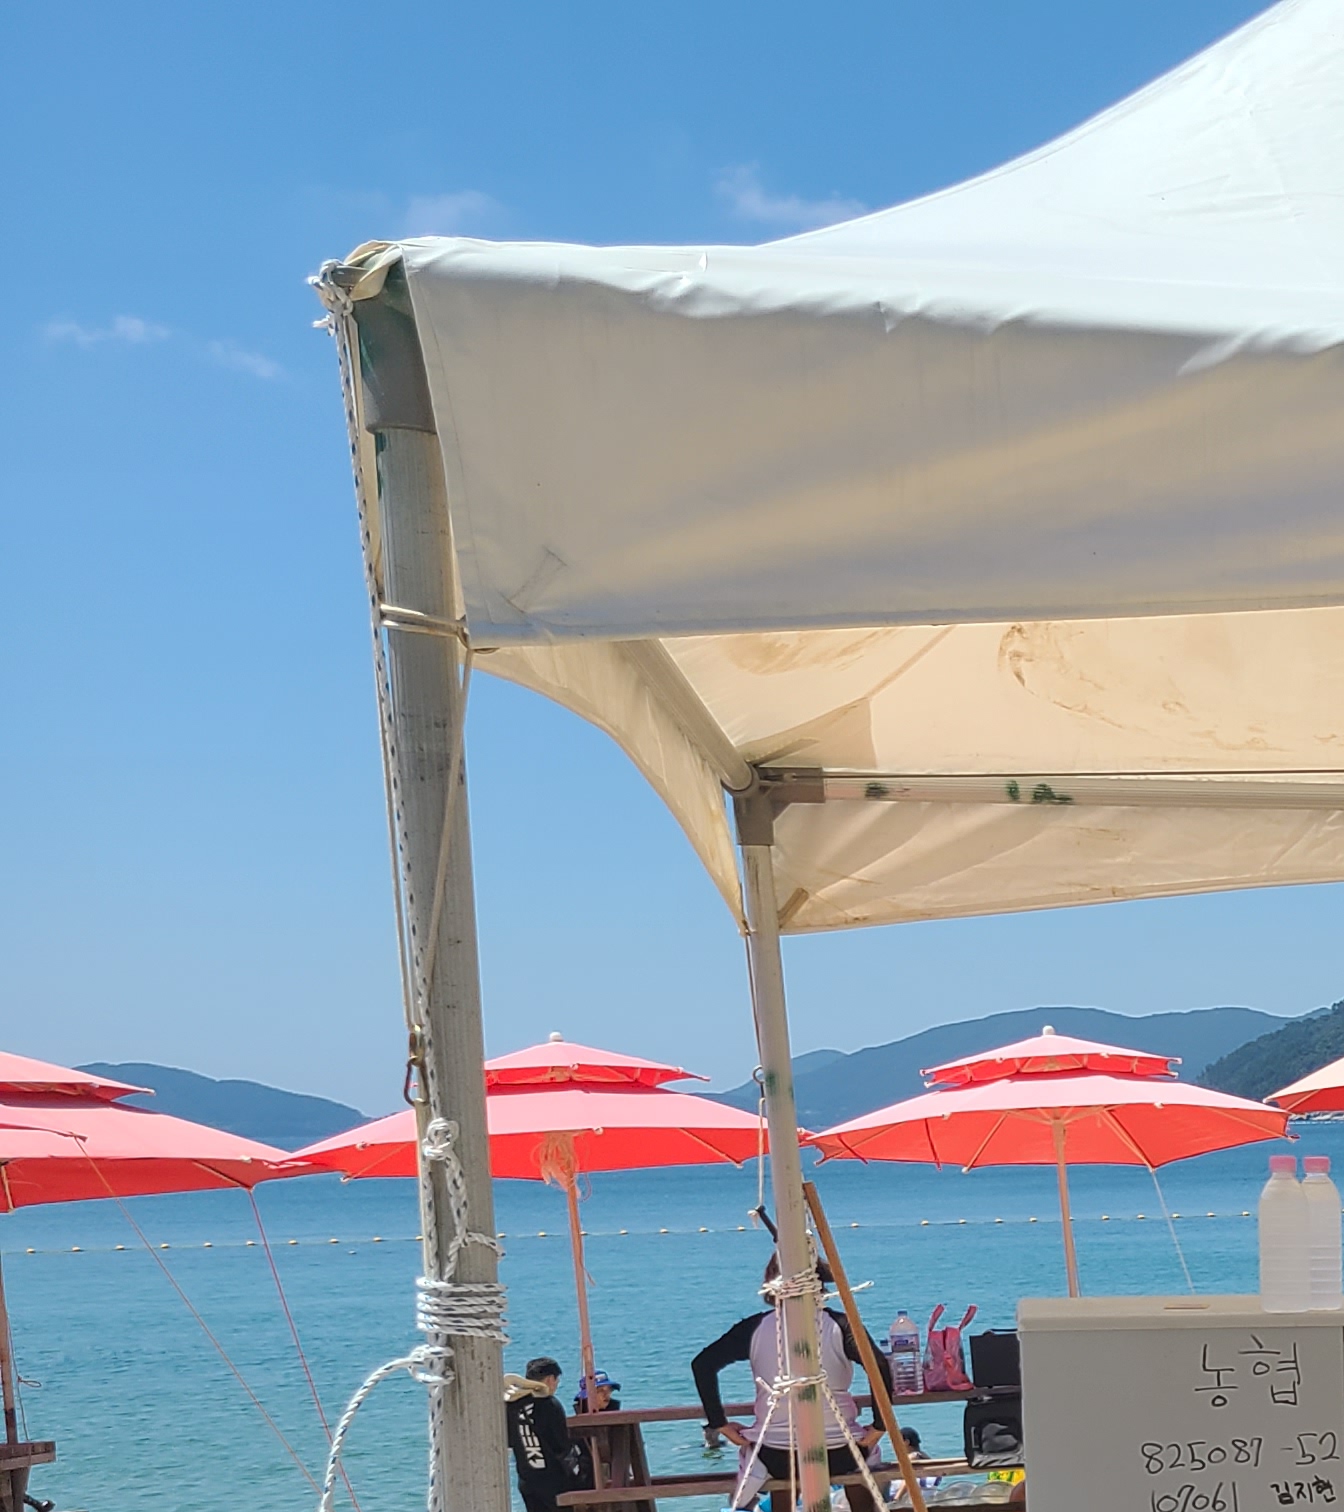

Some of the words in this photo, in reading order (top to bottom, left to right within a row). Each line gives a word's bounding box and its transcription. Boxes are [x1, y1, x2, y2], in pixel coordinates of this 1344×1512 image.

[1194, 1334, 1302, 1408] 농협
[1141, 1436, 1263, 1475] 825087
[1270, 1474, 1337, 1506] 김지현
